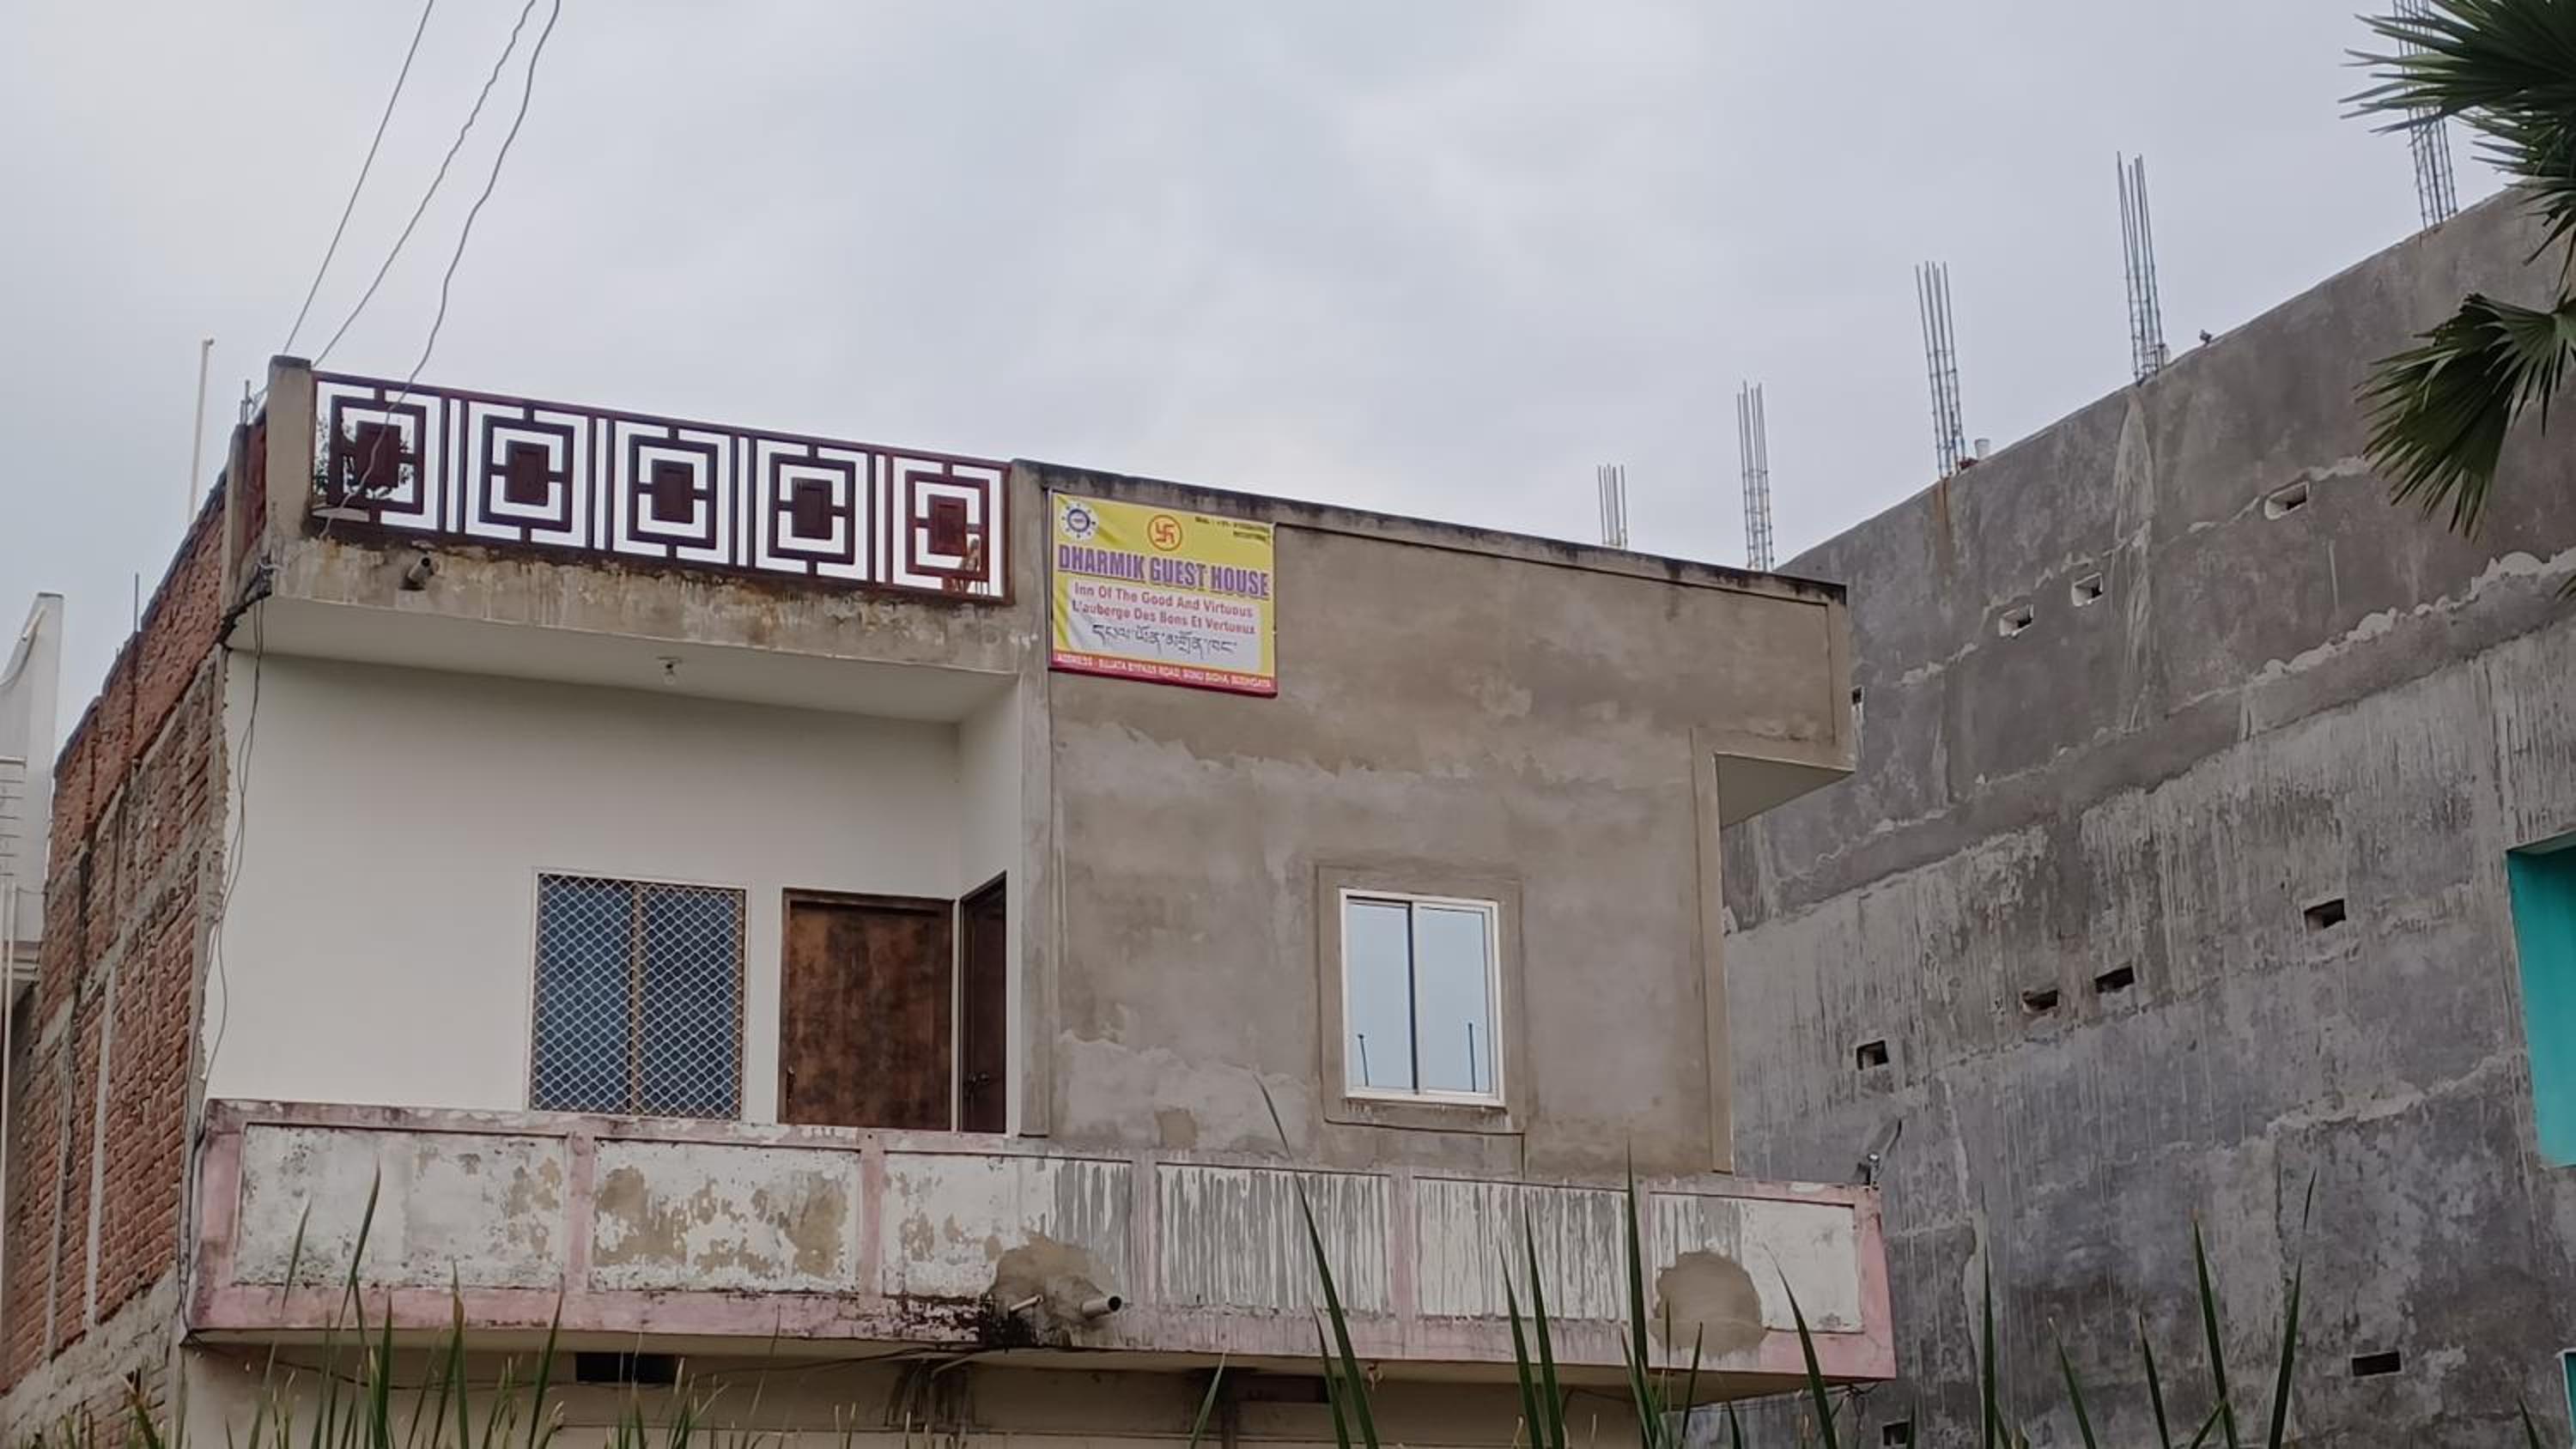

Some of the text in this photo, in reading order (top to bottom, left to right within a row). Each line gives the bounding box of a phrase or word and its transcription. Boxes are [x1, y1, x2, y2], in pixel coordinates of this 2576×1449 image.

[1058, 544, 1269, 597] DHARMIK GUEST HOUSE
[1074, 582, 1253, 618] Inn Of The Good And Virtuous
[1133, 607, 1156, 622] Des
